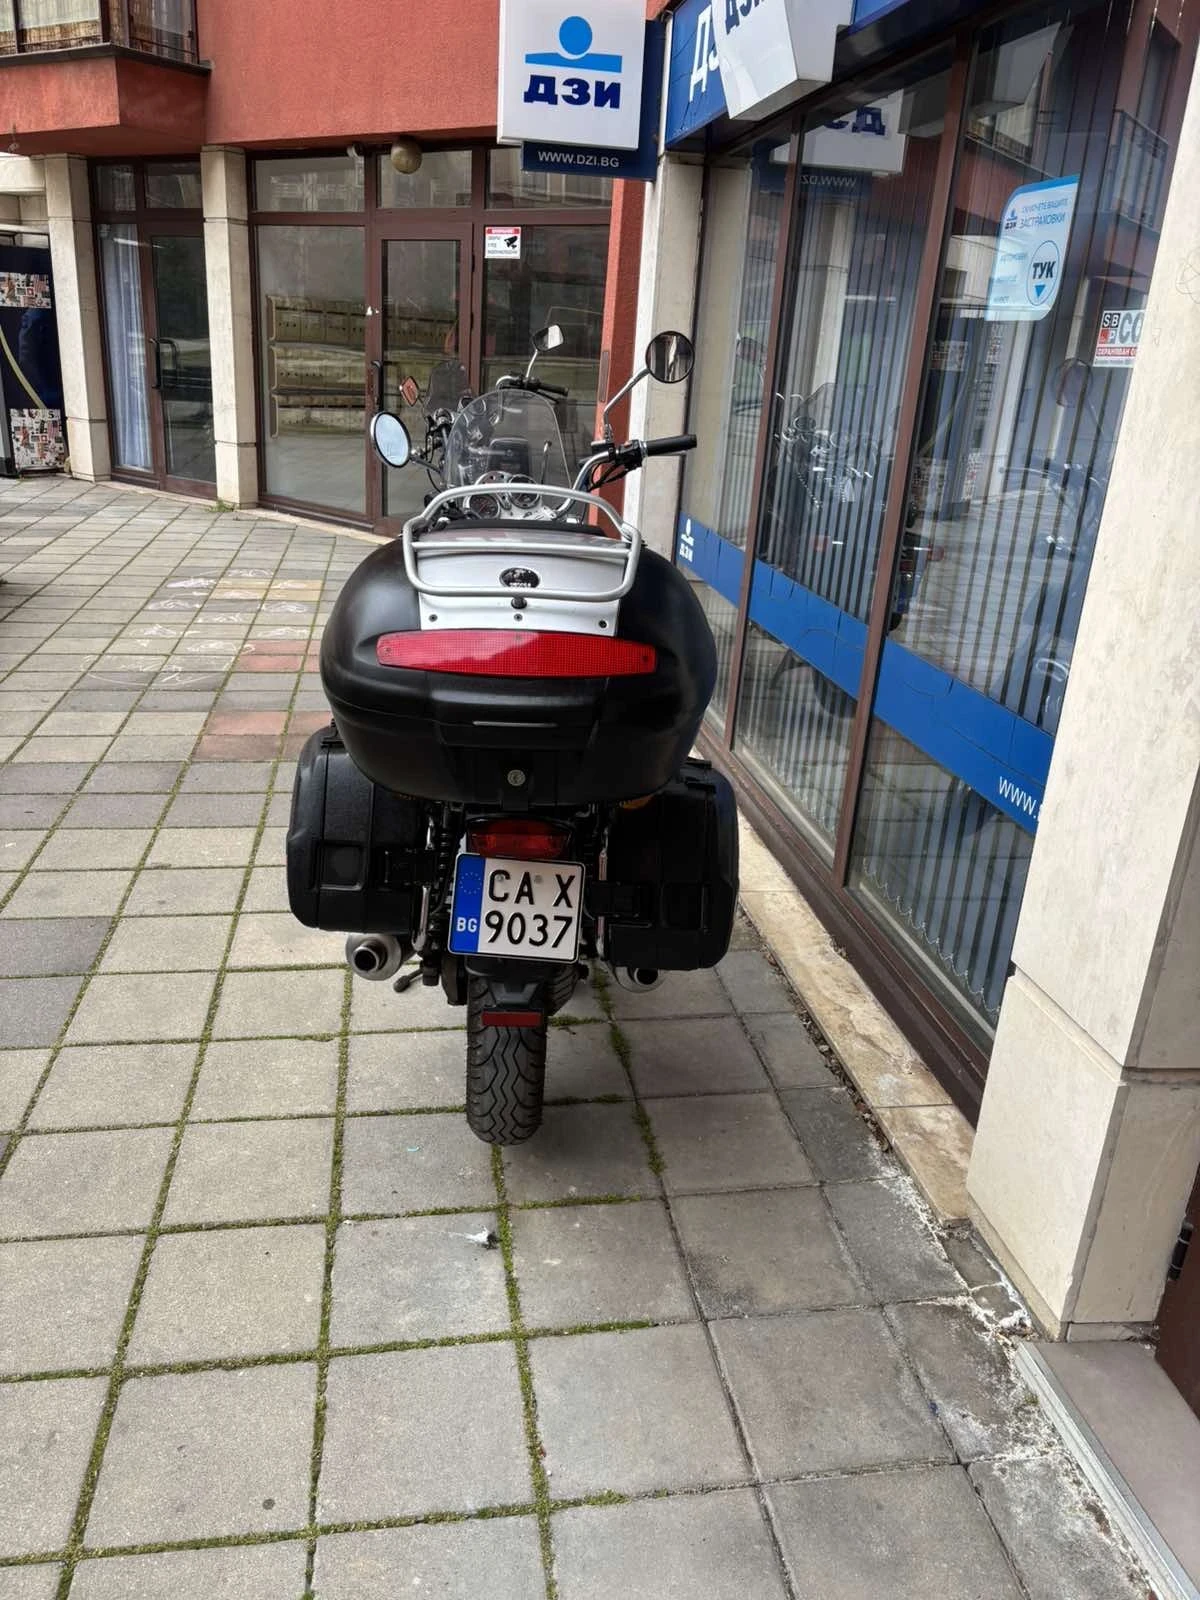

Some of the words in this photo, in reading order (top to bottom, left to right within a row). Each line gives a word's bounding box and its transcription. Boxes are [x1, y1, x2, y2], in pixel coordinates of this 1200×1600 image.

[523, 74, 621, 109] ДЗИ
[538, 151, 620, 168] WWW.DZI.BG
[1032, 261, 1056, 279] ТУК
[457, 917, 478, 932] BG
[485, 910, 573, 948] 9037
